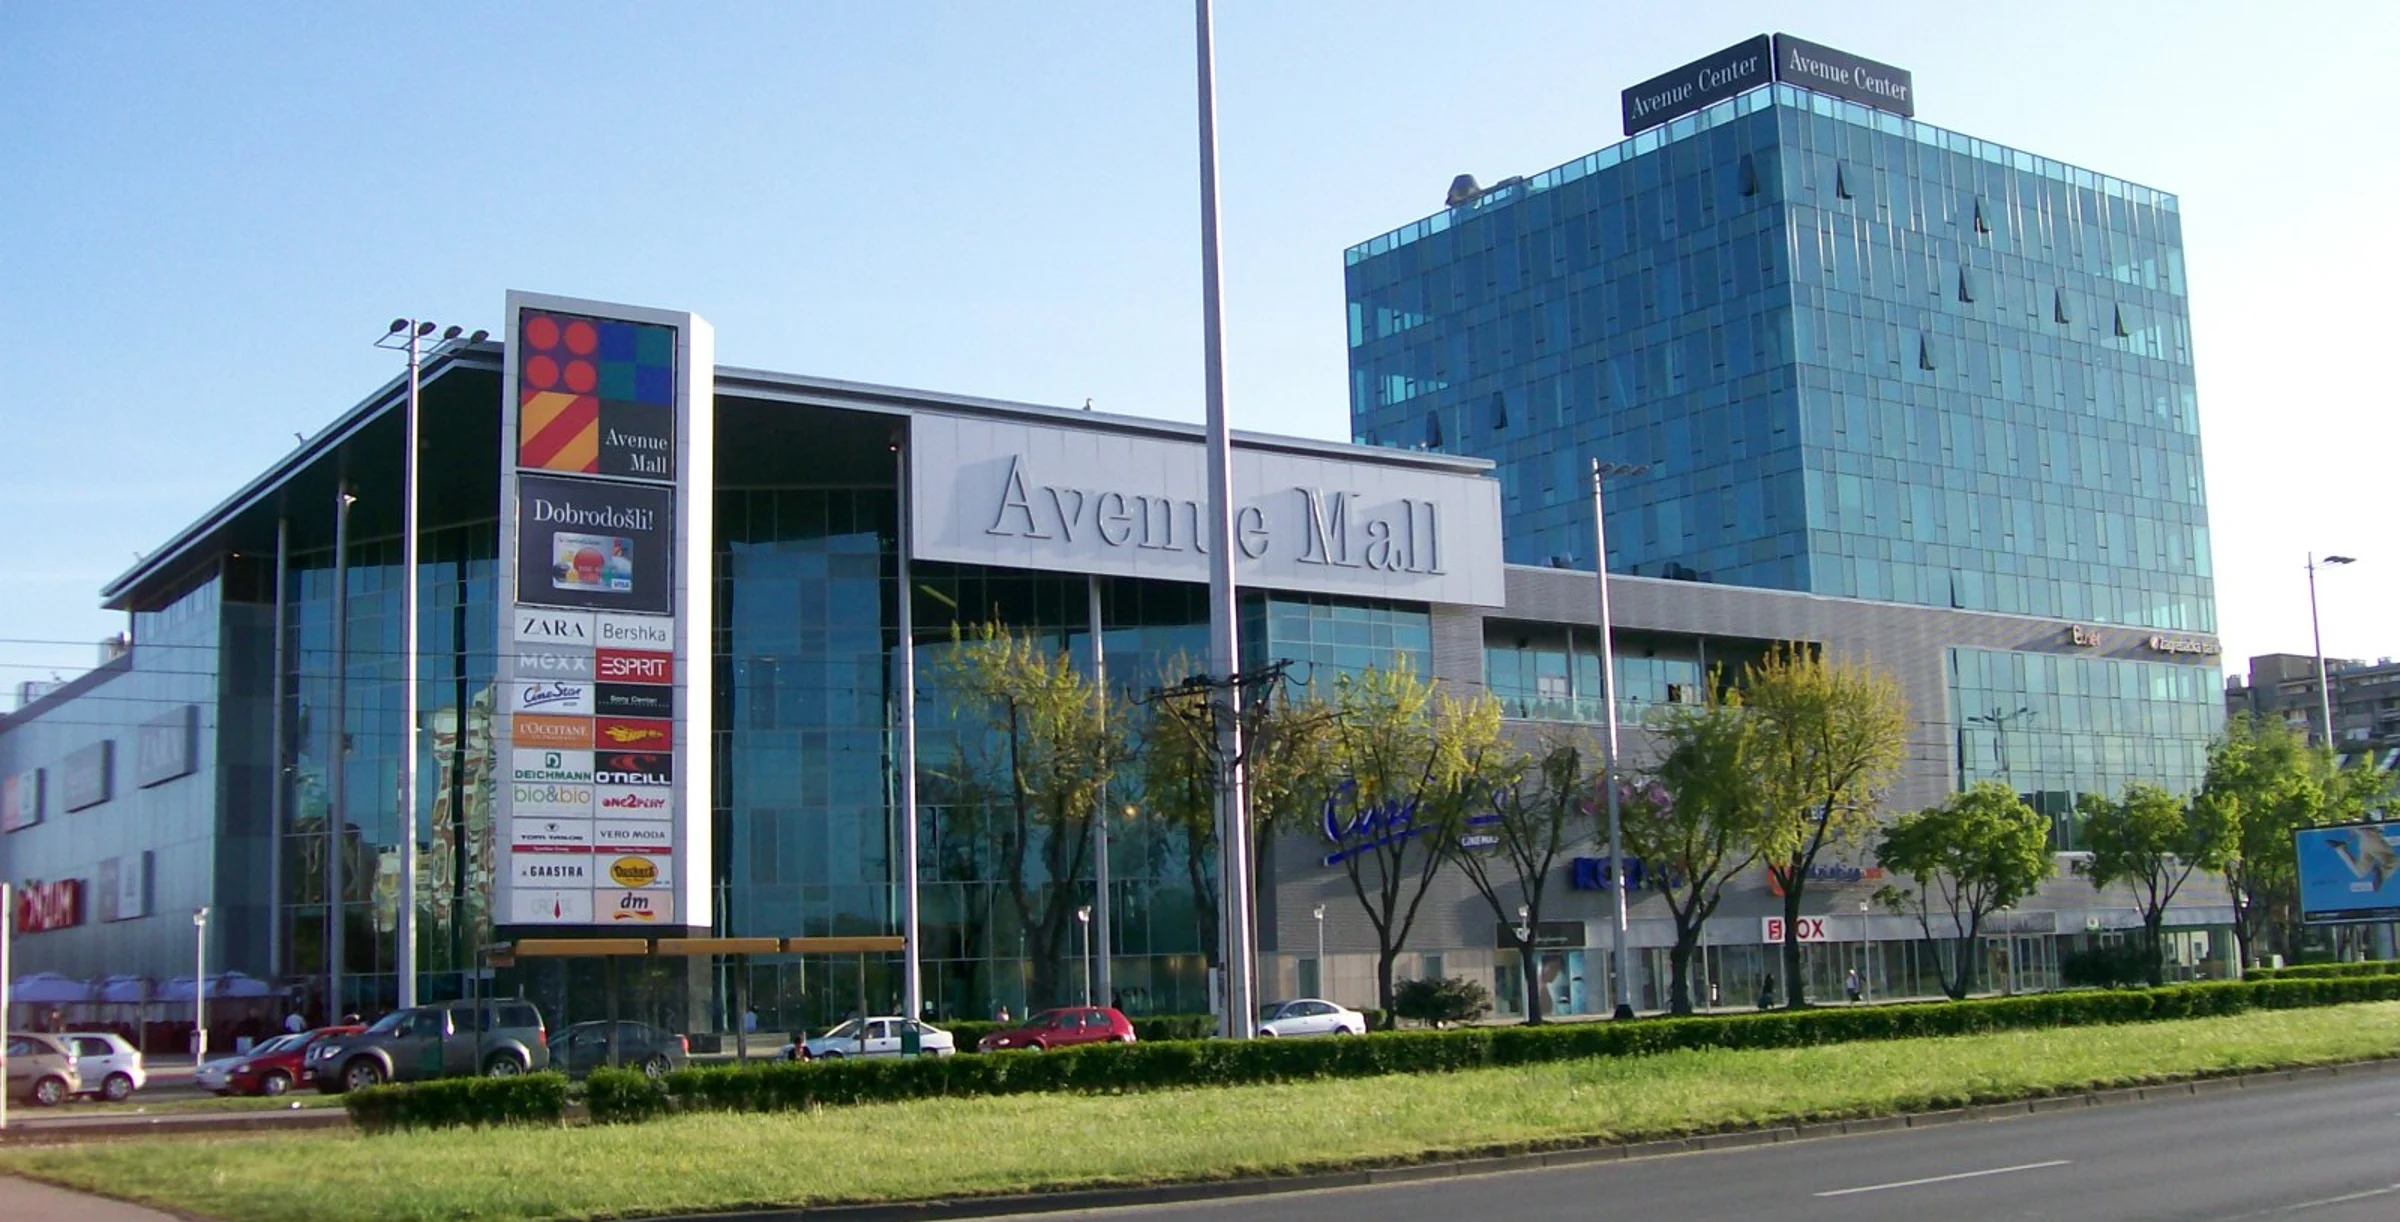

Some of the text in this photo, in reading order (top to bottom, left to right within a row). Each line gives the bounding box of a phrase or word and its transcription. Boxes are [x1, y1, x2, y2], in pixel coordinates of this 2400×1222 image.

[1789, 48, 1908, 101] Avenue Center
[1632, 54, 1758, 119] Avenue Center
[605, 427, 668, 451] Avenue
[630, 453, 667, 474] Mall
[533, 498, 654, 531] Dobrodošli!
[1295, 484, 1448, 576] Mall
[522, 616, 585, 638] ZARA
[603, 622, 667, 642] Bershka
[601, 656, 667, 678] ESPRIT
[514, 769, 592, 781] DEICHMANN
[514, 784, 591, 805] bio&bio
[600, 830, 666, 840] VERO MODA
[530, 865, 583, 878] GAASTRA
[620, 892, 649, 909] dm
